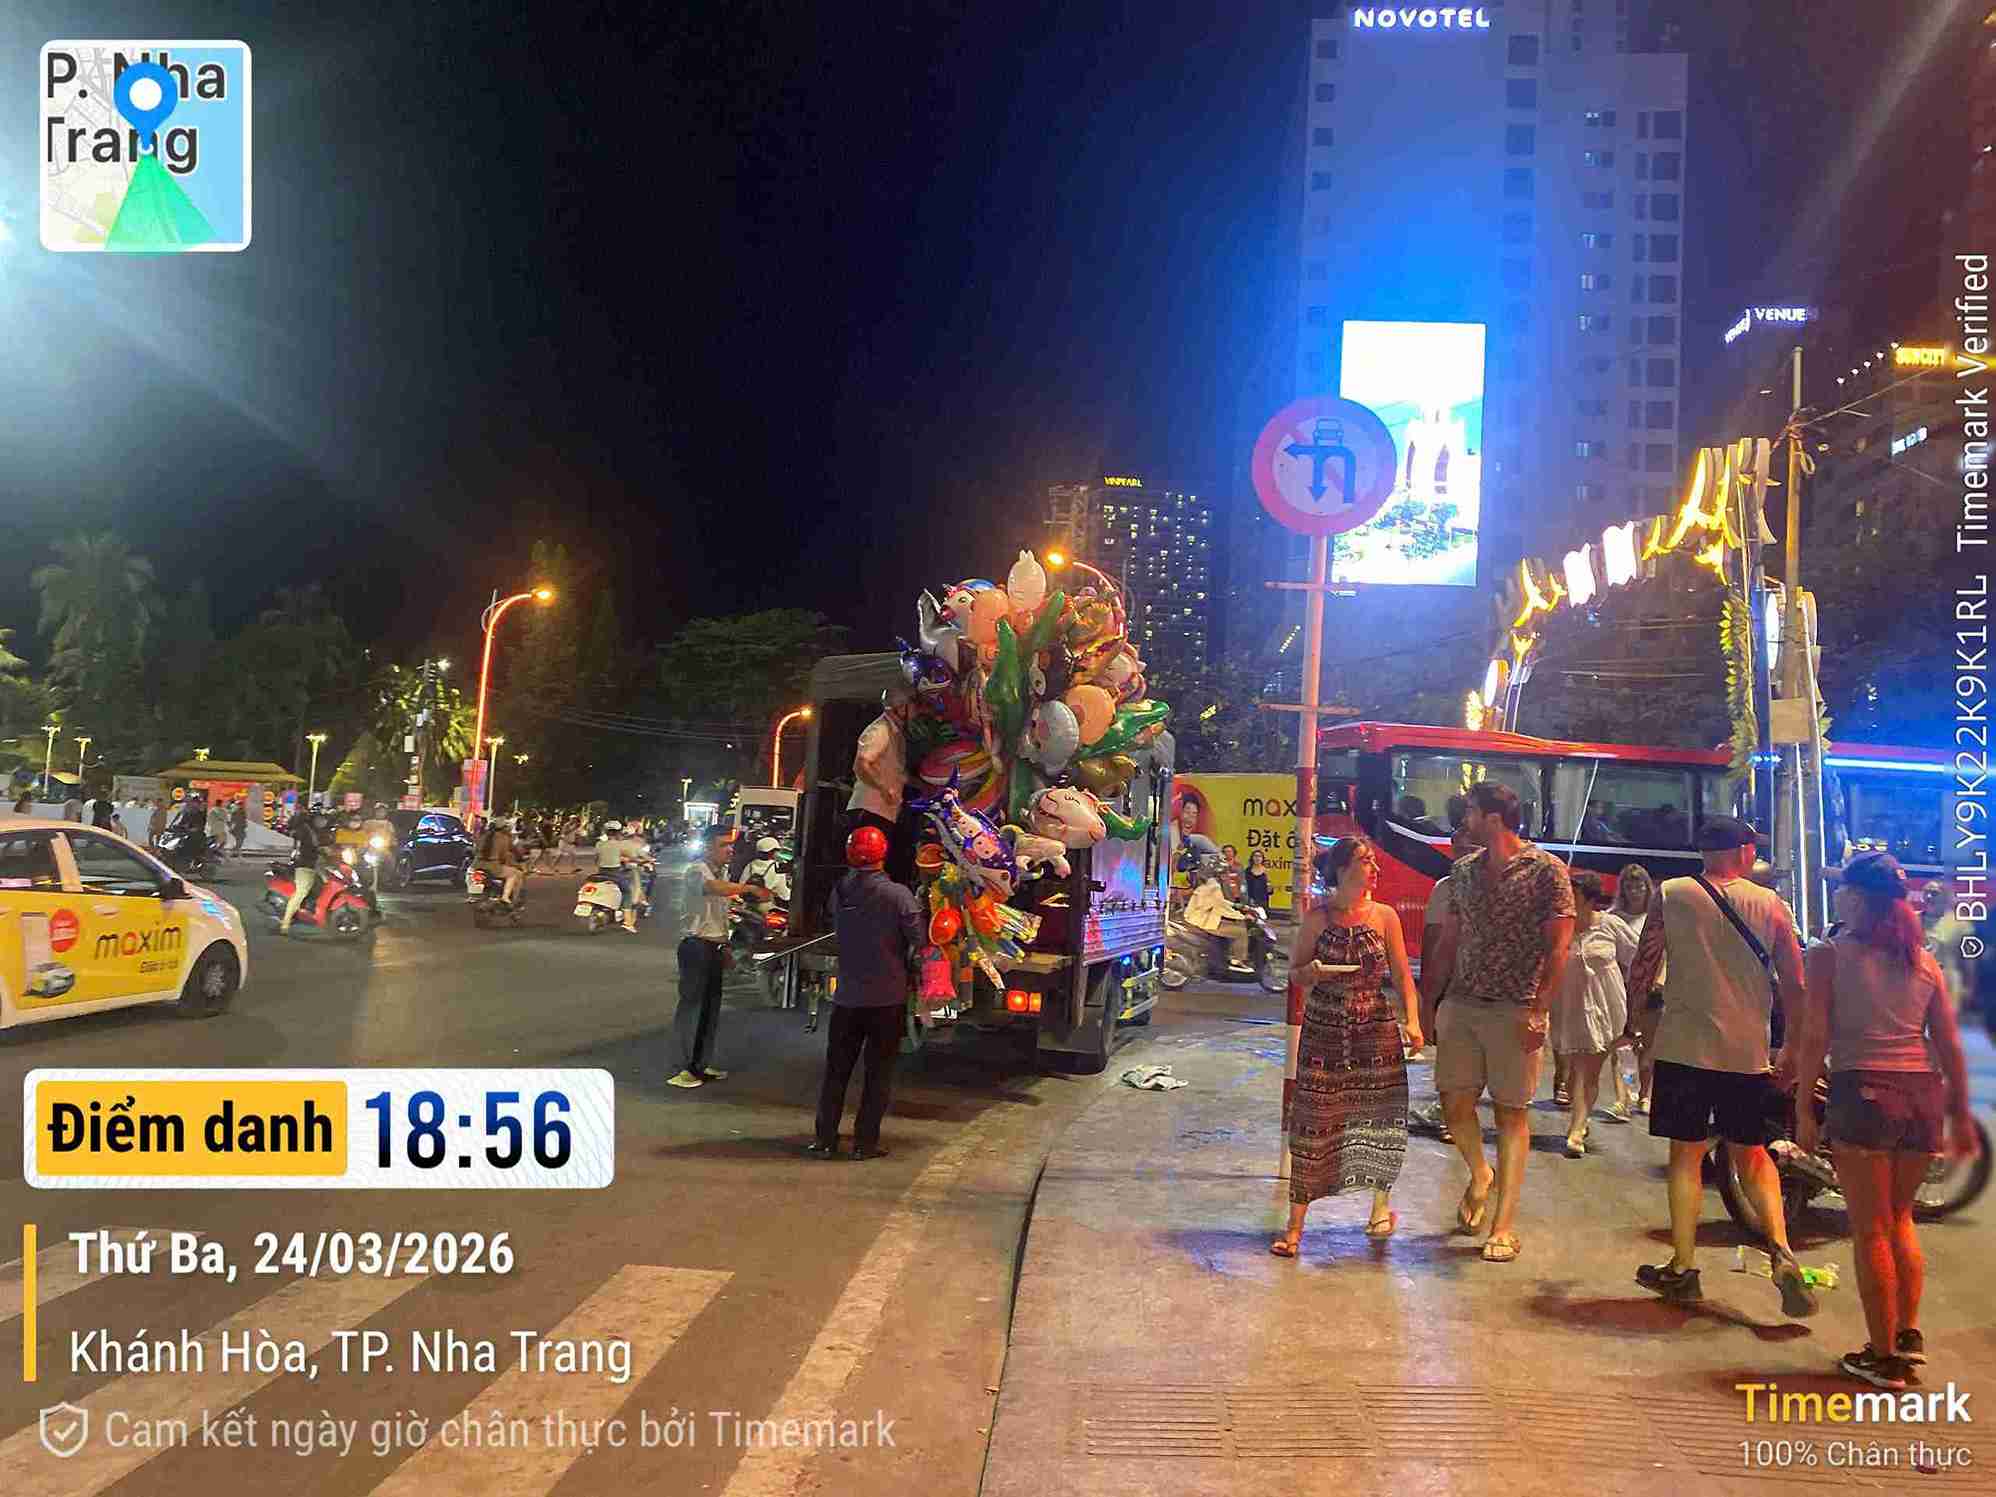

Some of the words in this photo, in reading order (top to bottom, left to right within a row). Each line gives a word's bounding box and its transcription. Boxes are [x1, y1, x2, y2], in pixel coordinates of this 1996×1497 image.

[1354, 8, 1490, 28] NOVOTEL
[1754, 308, 1806, 321] VENUE
[1246, 829, 1281, 852] Đặt
[94, 922, 182, 960] maxim
